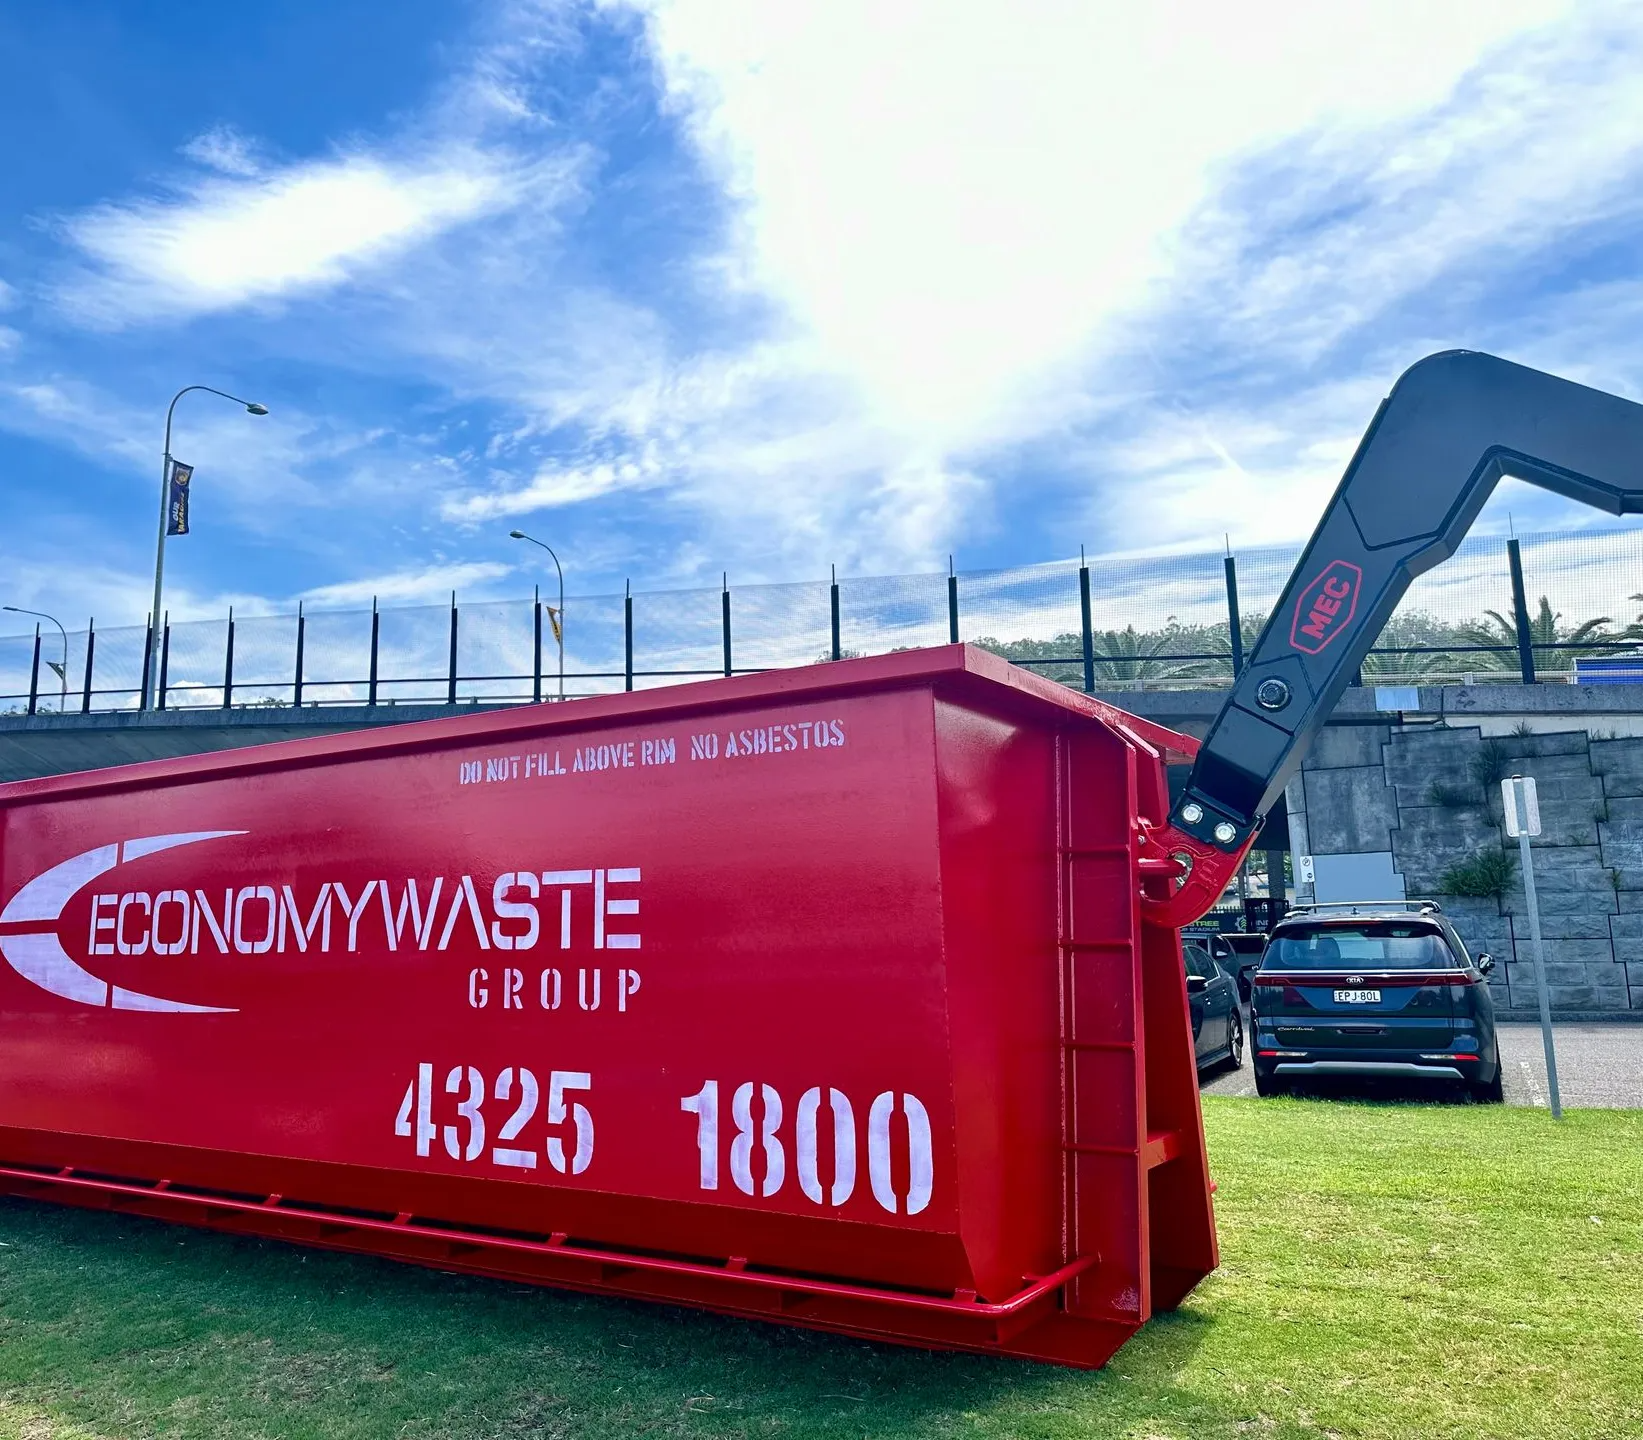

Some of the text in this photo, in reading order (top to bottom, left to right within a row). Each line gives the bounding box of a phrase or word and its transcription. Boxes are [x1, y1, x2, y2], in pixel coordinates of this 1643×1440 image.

[172, 501, 180, 522] OUR
[1300, 577, 1350, 639] MEC
[459, 719, 845, 785] DO NOT FILL ABOVE RIM NO ASBESTOS
[468, 967, 641, 1013] GROUP
[394, 1062, 934, 1215] 4325 1800
